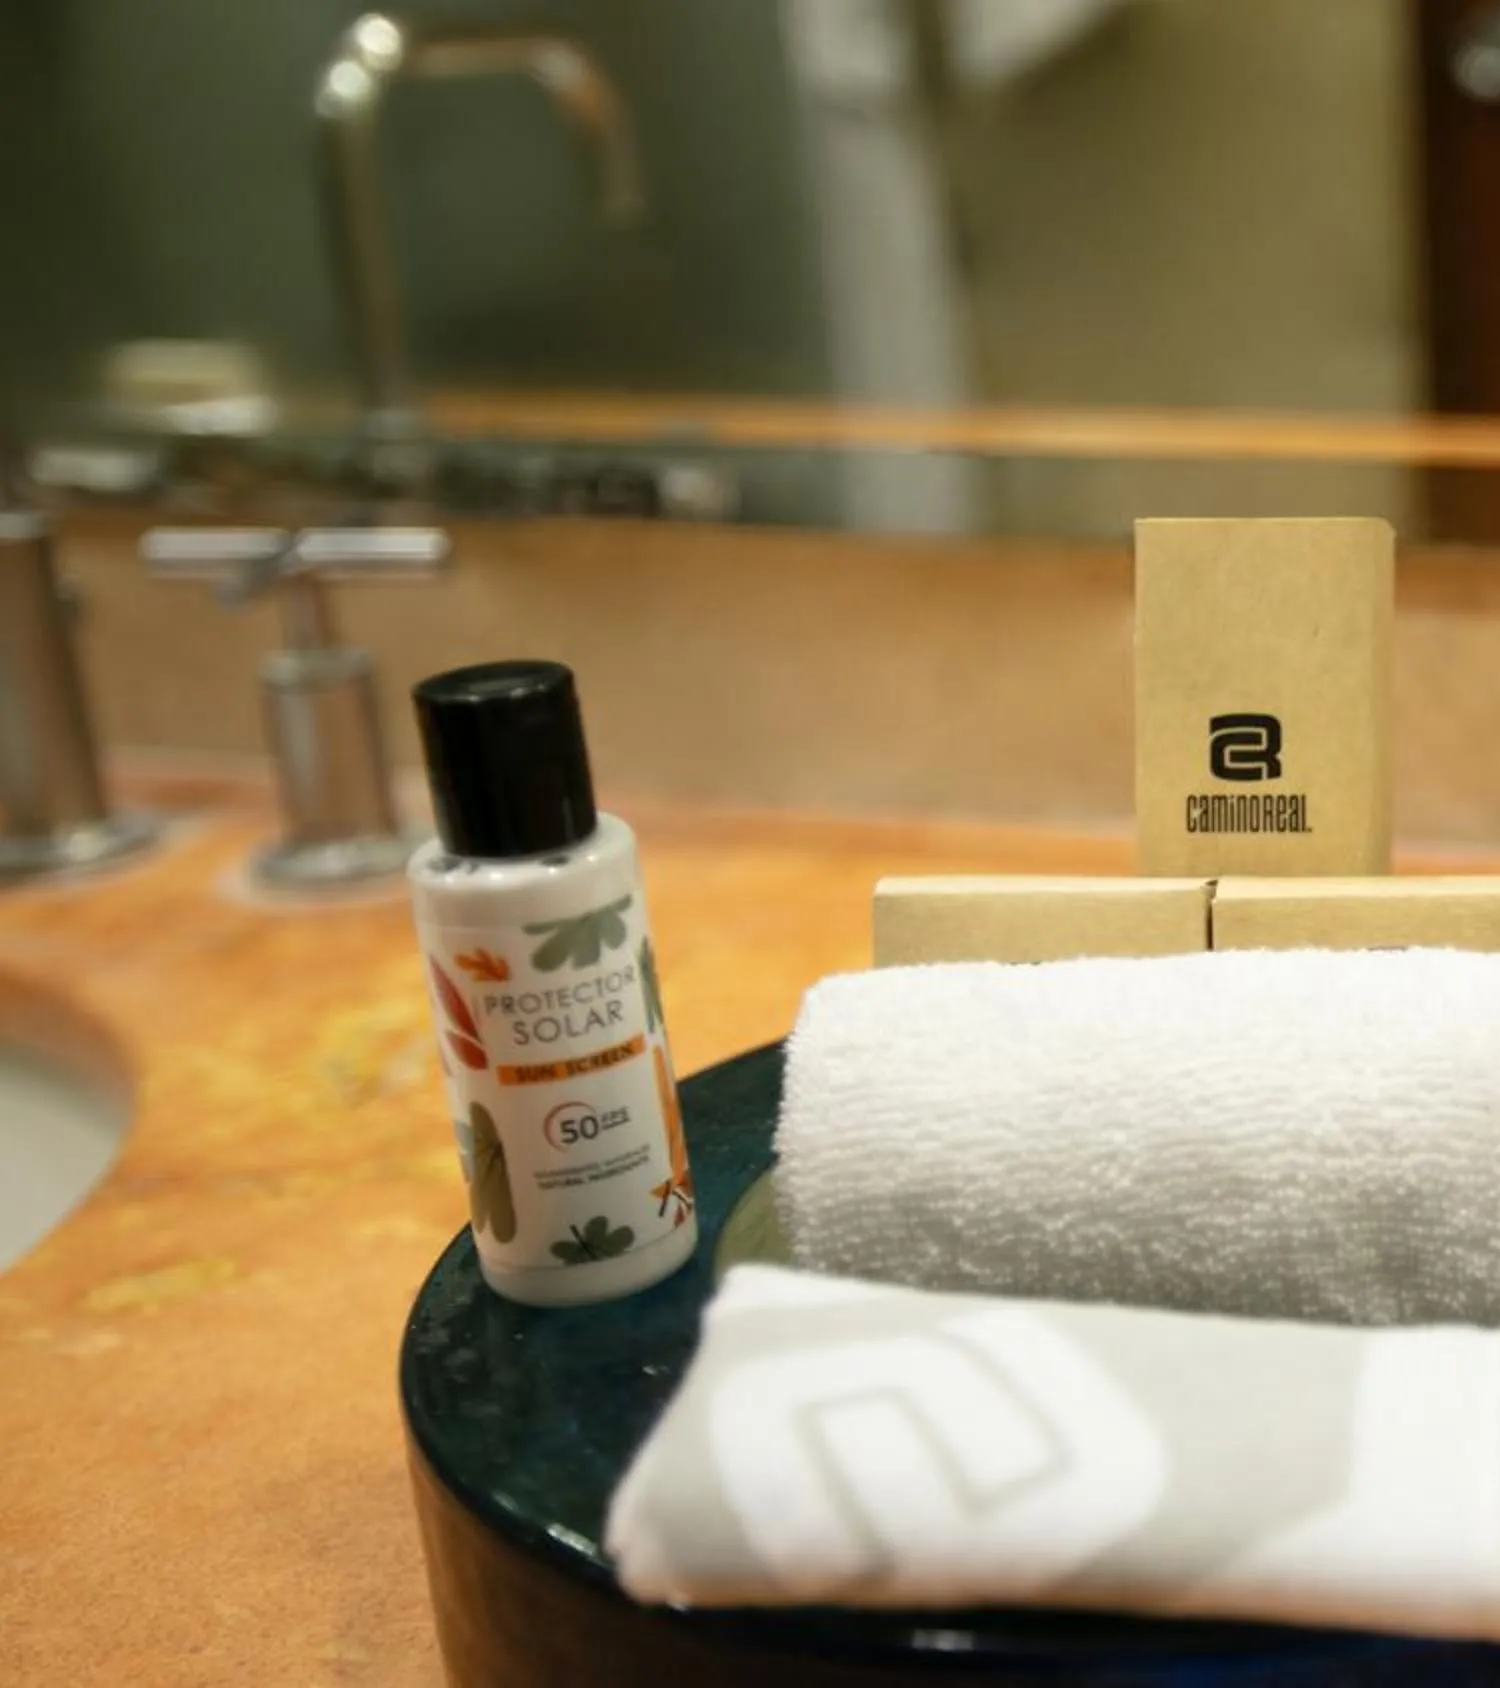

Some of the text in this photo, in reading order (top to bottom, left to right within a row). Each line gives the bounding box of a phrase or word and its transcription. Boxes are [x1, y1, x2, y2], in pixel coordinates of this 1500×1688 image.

[485, 965, 635, 1015] PROTECTOR
[513, 1000, 624, 1046] SOLAR
[516, 1043, 634, 1083] SUN SCREEN
[560, 1115, 599, 1145] 50
